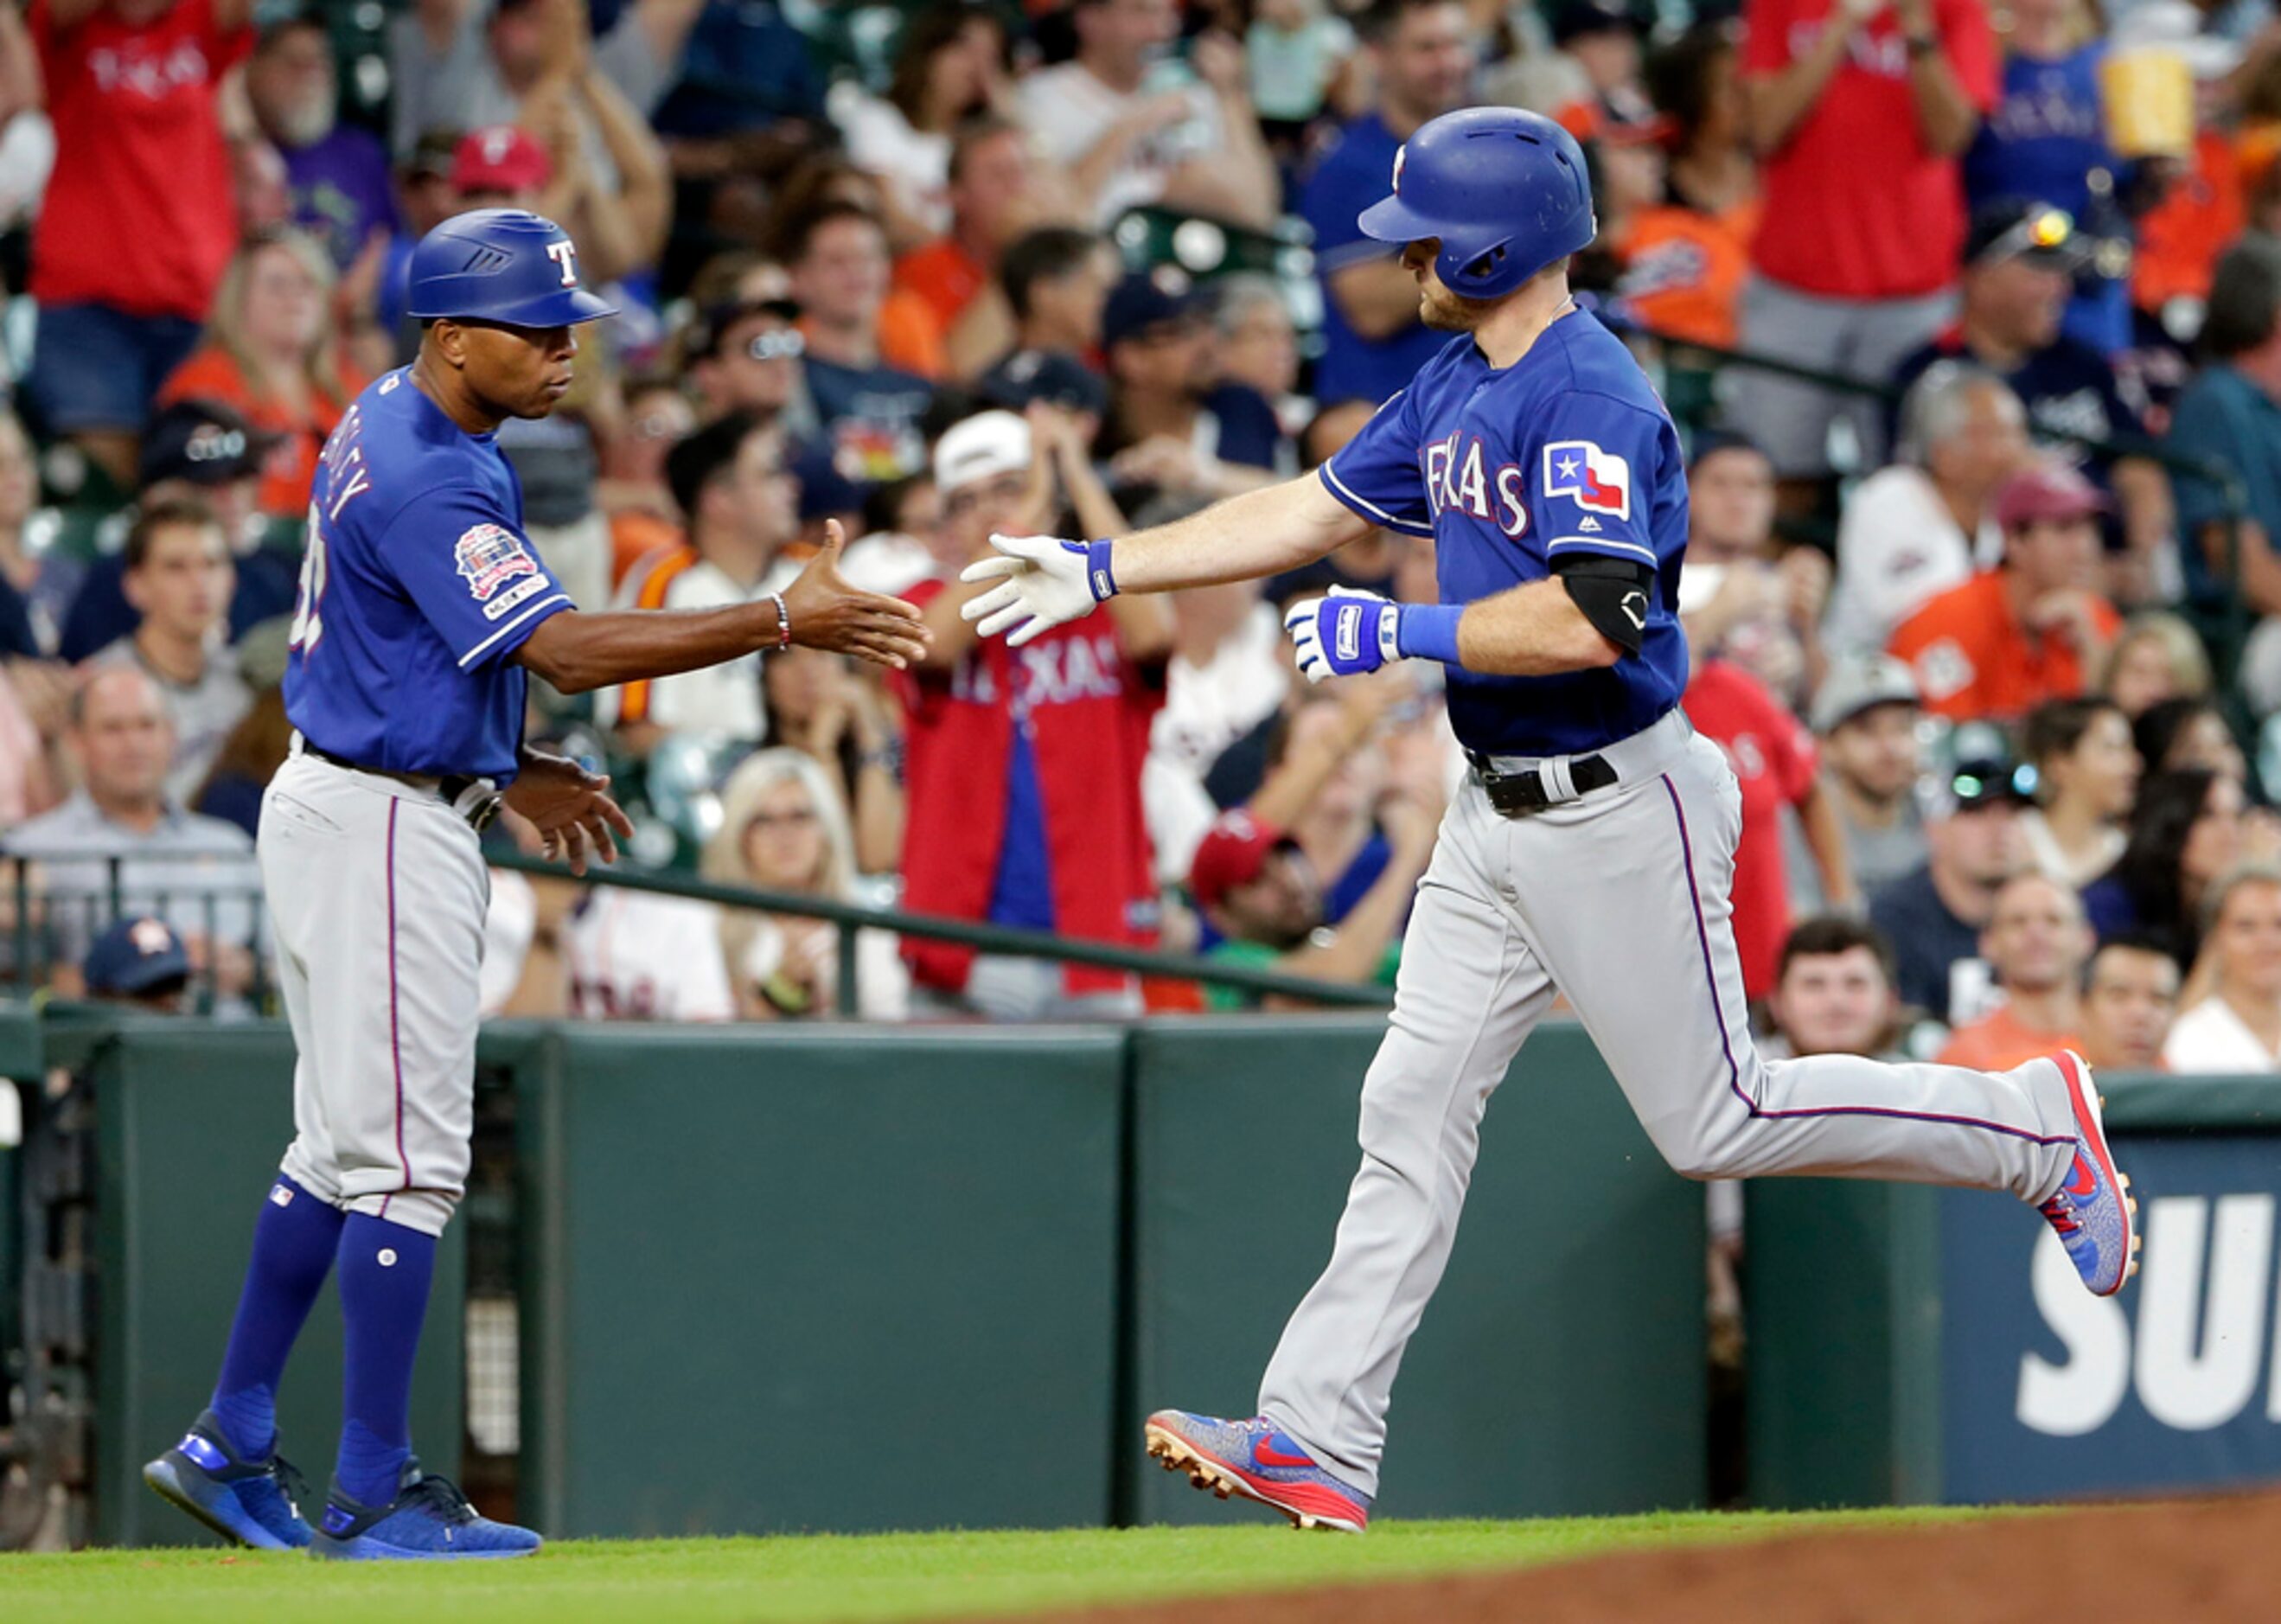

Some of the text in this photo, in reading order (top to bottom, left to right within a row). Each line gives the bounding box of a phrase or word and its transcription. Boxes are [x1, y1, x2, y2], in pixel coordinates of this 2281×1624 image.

[546, 239, 577, 287] T
[1419, 430, 1530, 540] EXAS
[2016, 1194, 2281, 1436] SU
